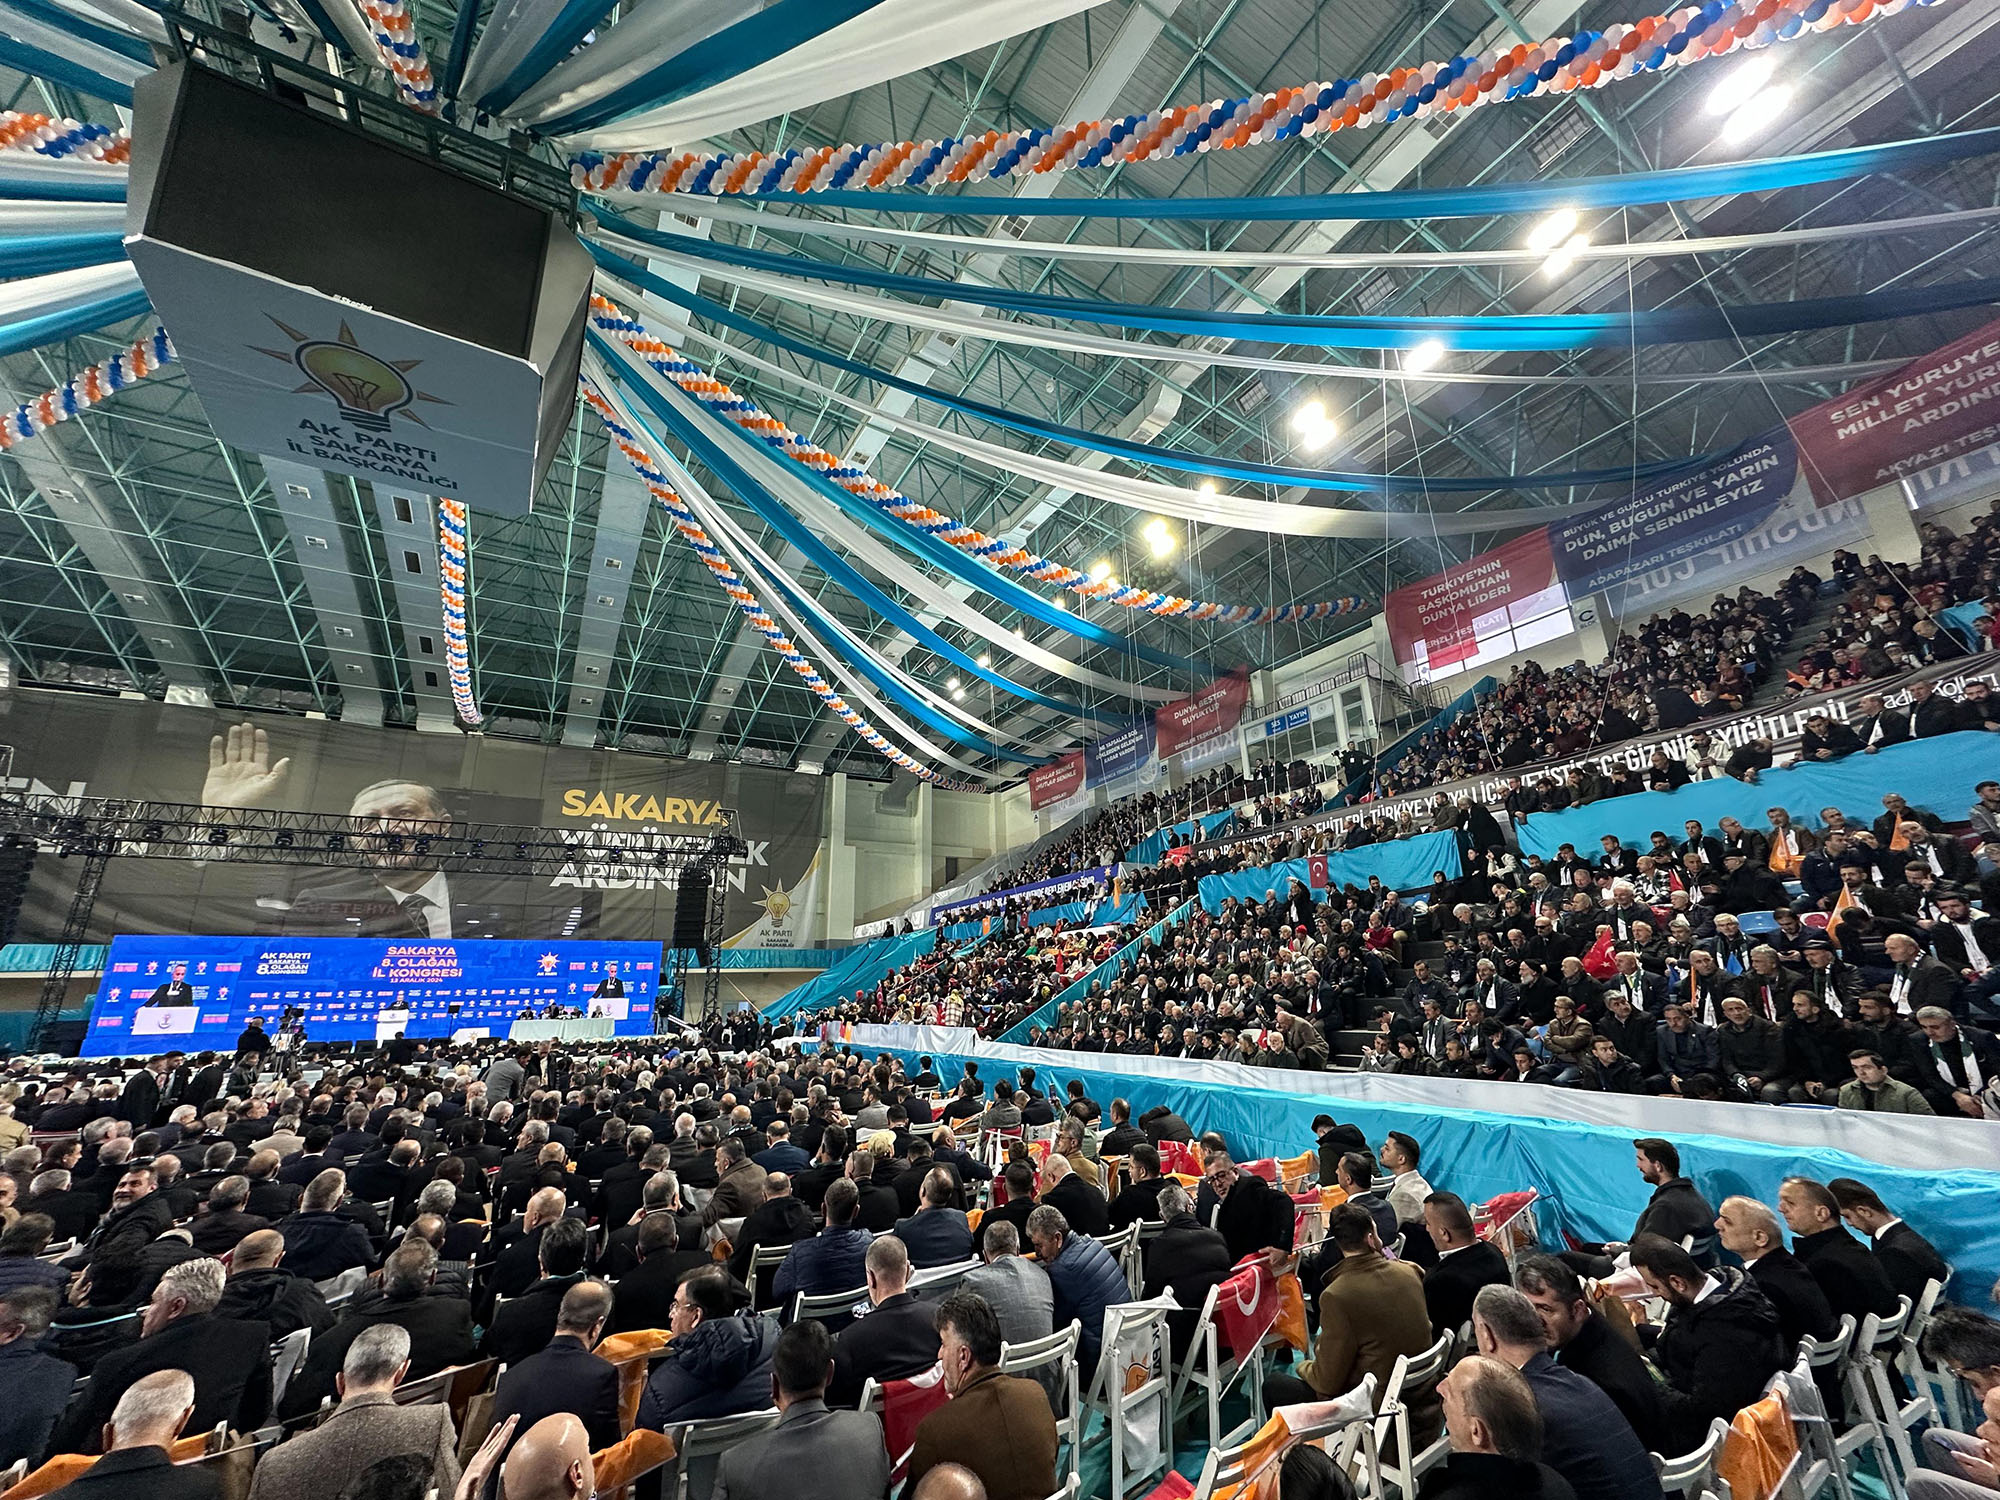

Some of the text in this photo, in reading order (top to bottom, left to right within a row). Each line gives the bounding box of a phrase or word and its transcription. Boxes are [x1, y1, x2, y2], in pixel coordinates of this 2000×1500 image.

[1830, 395, 1881, 424] SEN
[299, 417, 344, 439] AK
[286, 437, 458, 490] İL BAŞKANLIĞI
[309, 434, 430, 473] SAKARYA
[1875, 444, 1950, 480] AKYAZI
[1600, 510, 1615, 522] VE
[1710, 444, 1772, 475] YOLUNDA
[1680, 484, 1708, 503] VE
[1711, 453, 1779, 489] YARIN
[1587, 552, 1664, 589] ADAPAZARI
[1417, 569, 1511, 614] BAŞKOMUTANI
[1579, 610, 1595, 622] C
[381, 956, 458, 967] 8. OLAĞAN
[387, 946, 457, 955] SAKARYA
[389, 968, 462, 977] KONGRESİ
